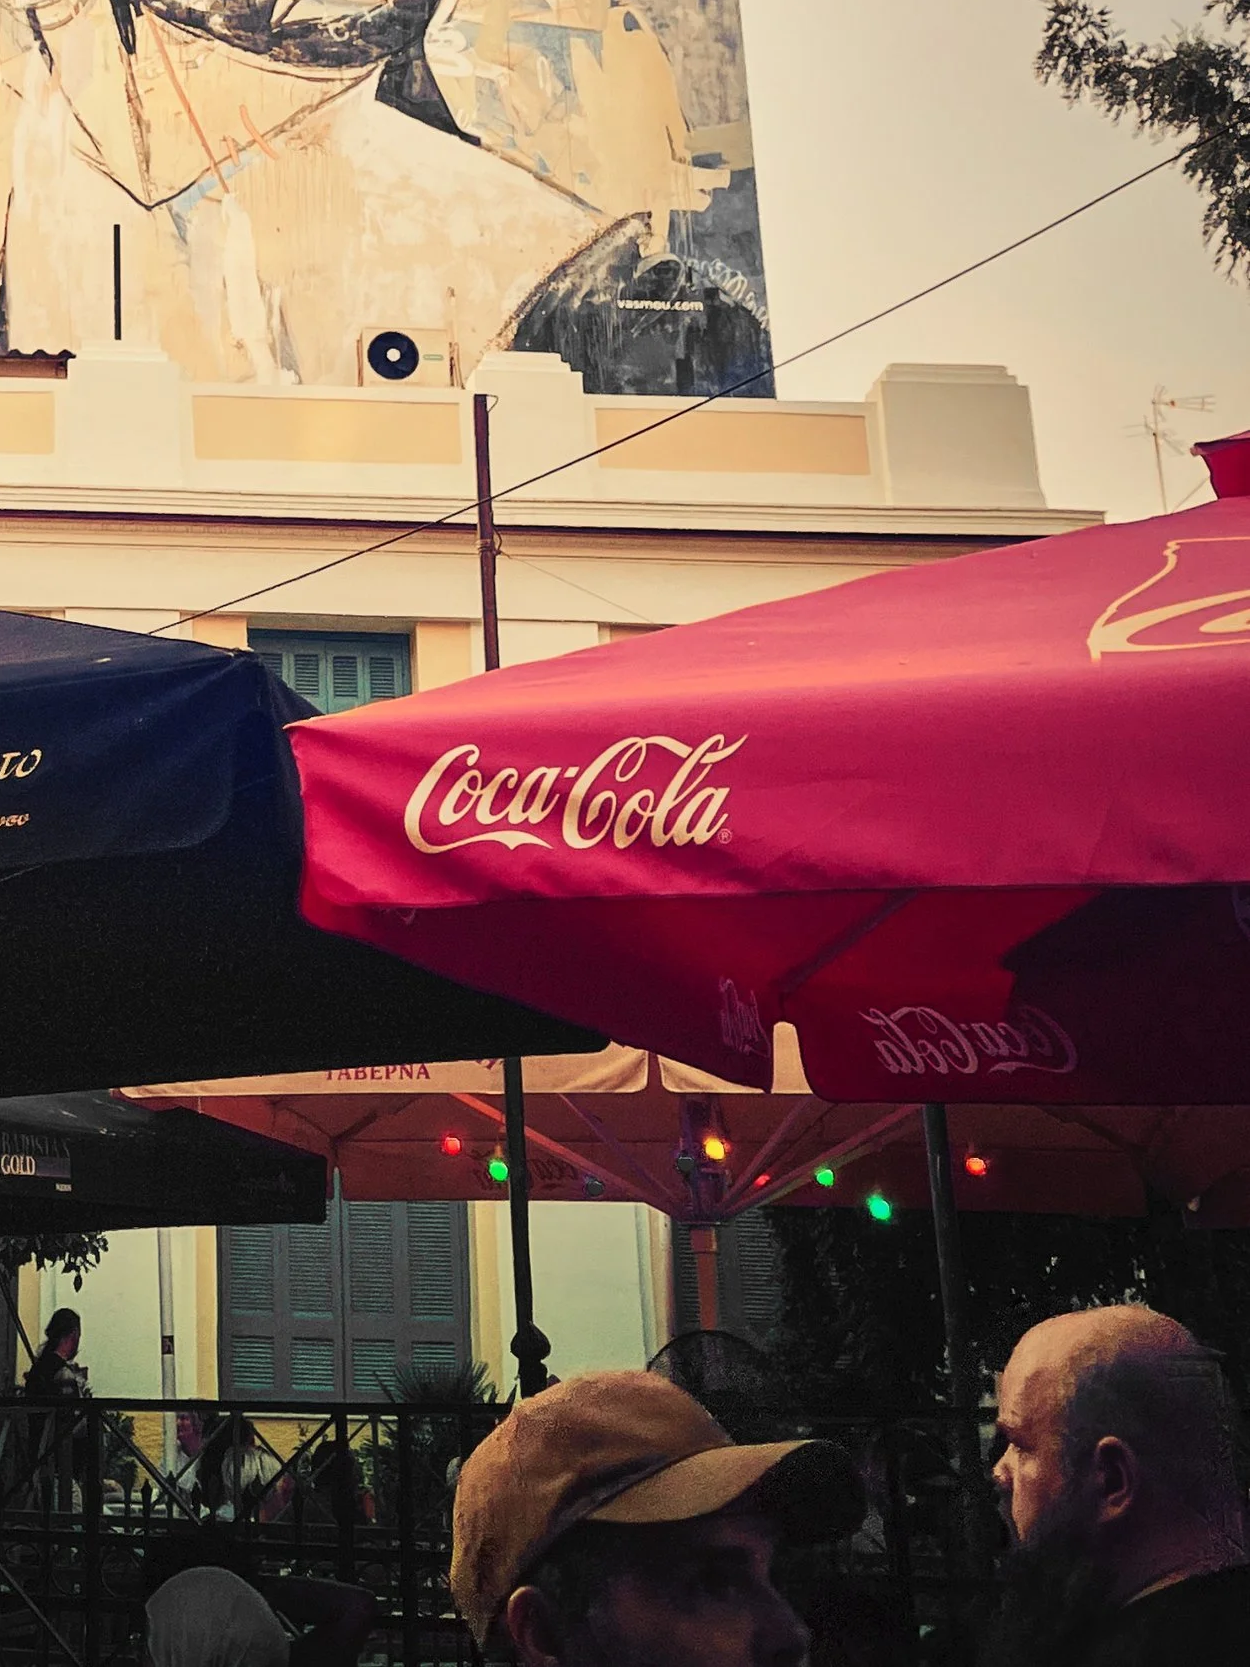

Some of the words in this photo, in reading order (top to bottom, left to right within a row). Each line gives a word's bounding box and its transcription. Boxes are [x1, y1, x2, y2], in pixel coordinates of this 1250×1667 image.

[617, 299, 704, 312] vasmou.com
[404, 733, 749, 854] Coca-Cola
[0, 1154, 36, 1176] GOLD
